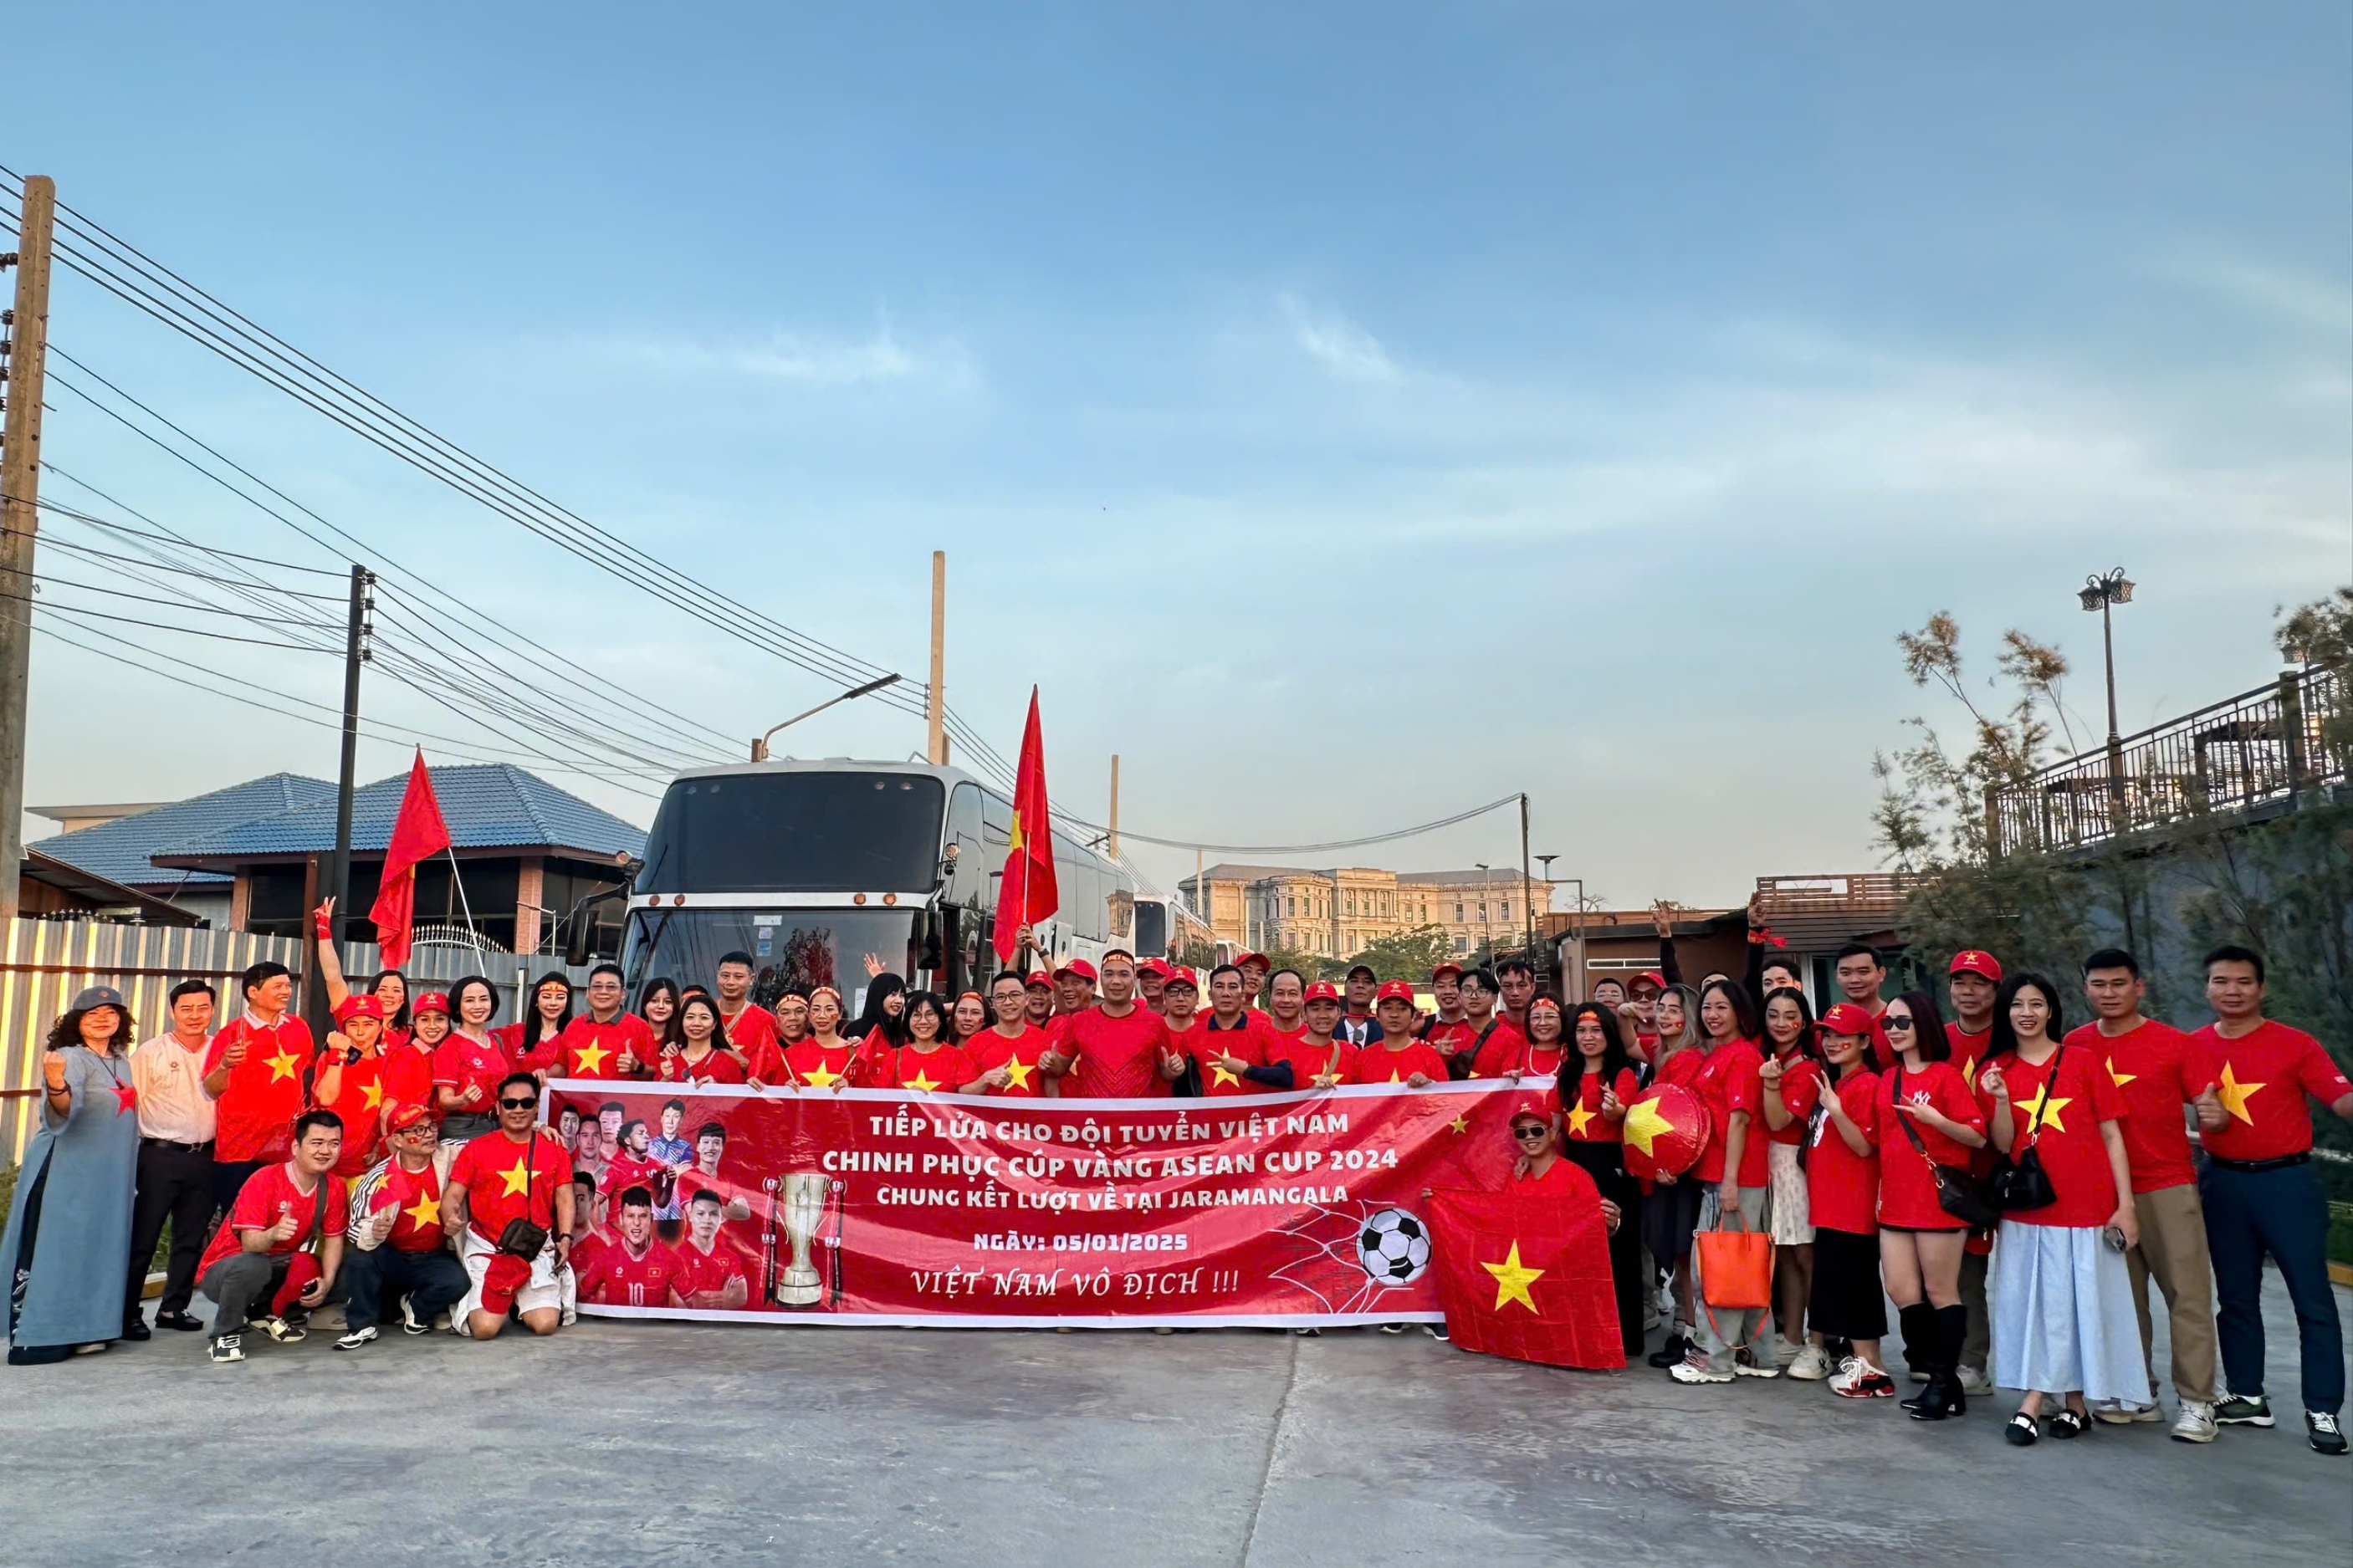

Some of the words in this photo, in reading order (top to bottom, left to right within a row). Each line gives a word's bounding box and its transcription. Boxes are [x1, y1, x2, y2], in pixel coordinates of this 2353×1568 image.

[870, 1104, 927, 1136] TIẾP
[934, 1111, 987, 1140] LỬA
[995, 1121, 1051, 1142] CHO
[1060, 1117, 1111, 1148] ĐỘI
[1119, 1111, 1210, 1142] TUYỂN
[1219, 1112, 1280, 1143] VIỆT
[1287, 1113, 1348, 1134] NAM
[822, 1151, 913, 1173] CHINH
[923, 1153, 1001, 1182] PHỤC
[1008, 1148, 1064, 1177] CÚP
[1073, 1149, 1152, 1178] VÀNG
[1160, 1153, 1255, 1177] ASEAN
[1265, 1151, 1322, 1172] CUP
[1329, 1148, 1399, 1170] 2024
[877, 1187, 959, 1207] CHUNG
[967, 1179, 1010, 1208] KẾT
[1018, 1192, 1081, 1215] LƯỢT
[1087, 1181, 1117, 1211] VỀ
[1124, 1192, 1162, 1214] TẠI
[1169, 1185, 1348, 1208] JARAMANGALA
[1053, 1233, 1188, 1253] 05/01/2025
[628, 1282, 644, 1305] 10
[911, 1264, 985, 1299] VIỆT
[993, 1268, 1065, 1296] NAM
[1071, 1266, 1111, 1295] VÔ
[1123, 1267, 1205, 1299] ĐỊCH
[1212, 1269, 1239, 1293] !!!
